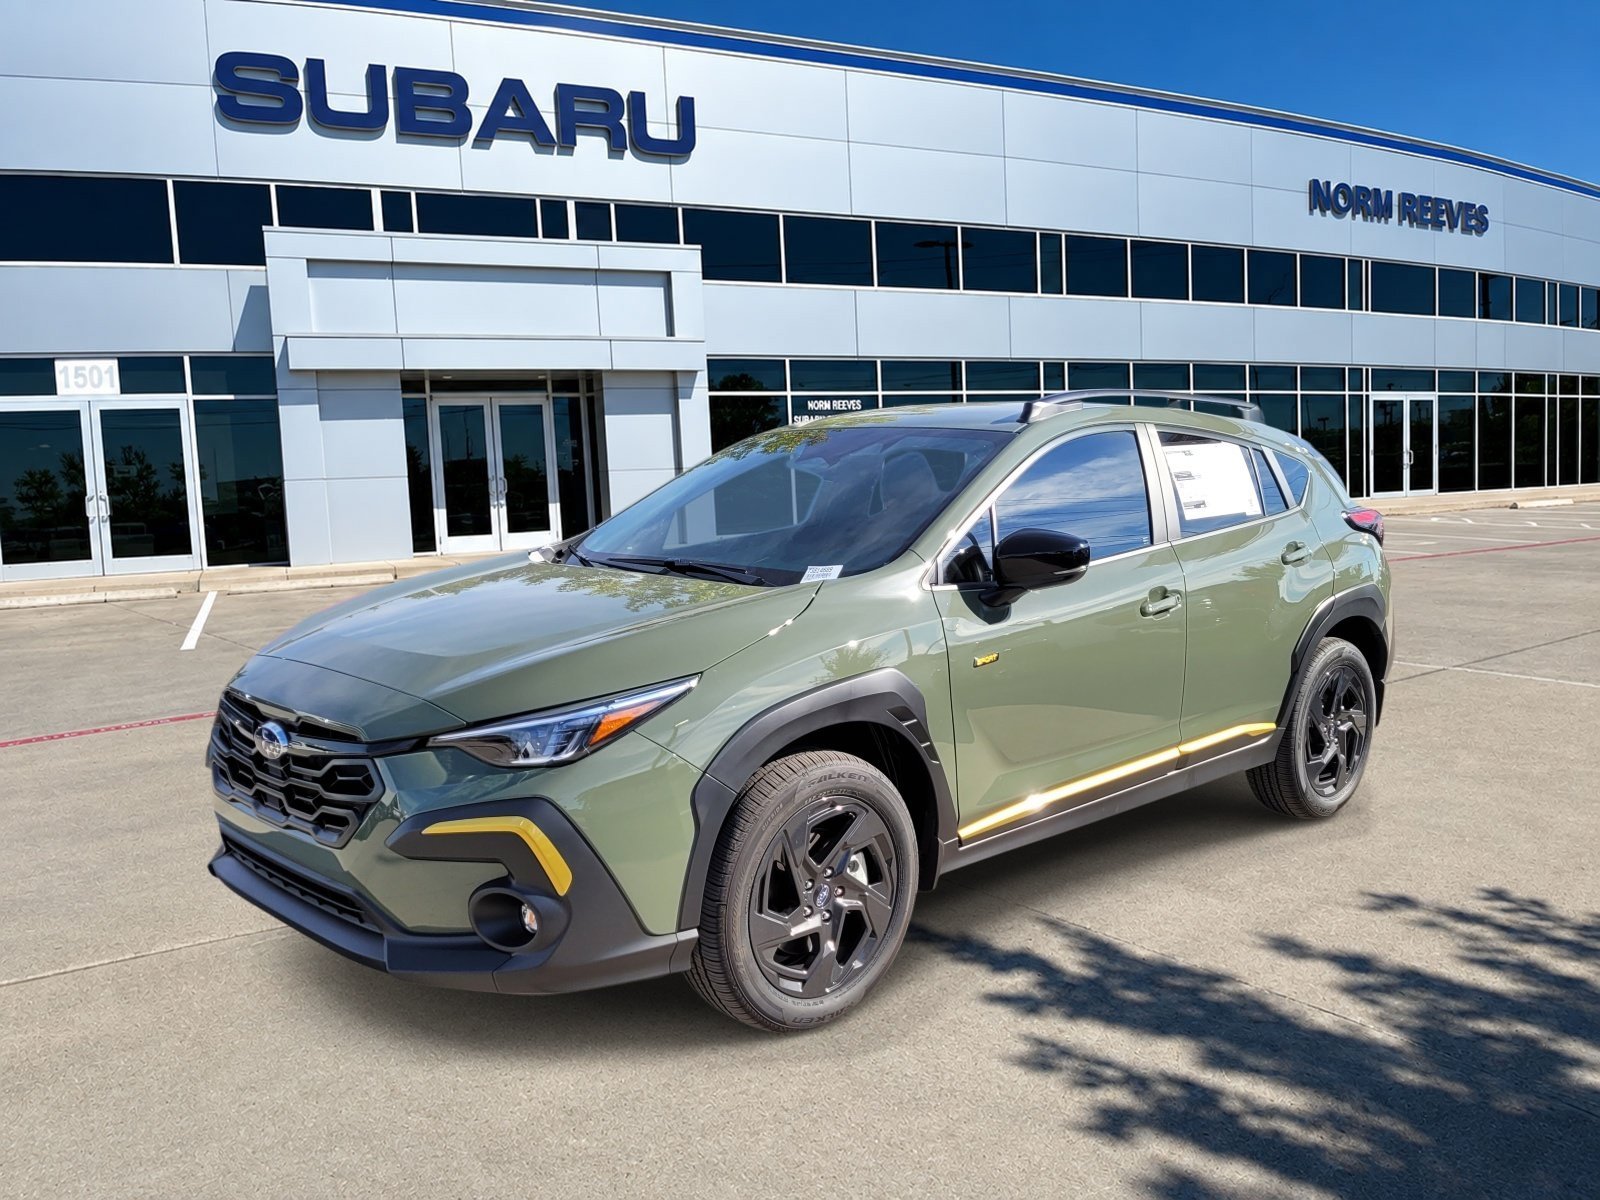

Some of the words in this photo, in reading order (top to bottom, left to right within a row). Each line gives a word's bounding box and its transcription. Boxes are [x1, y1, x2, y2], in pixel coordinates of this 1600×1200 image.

[214, 51, 696, 157] SUBARU
[1308, 178, 1393, 221] NORM
[1398, 191, 1490, 234] REEVES
[59, 365, 115, 389] 1501
[807, 400, 831, 411] NORM
[832, 399, 862, 411] REEVES
